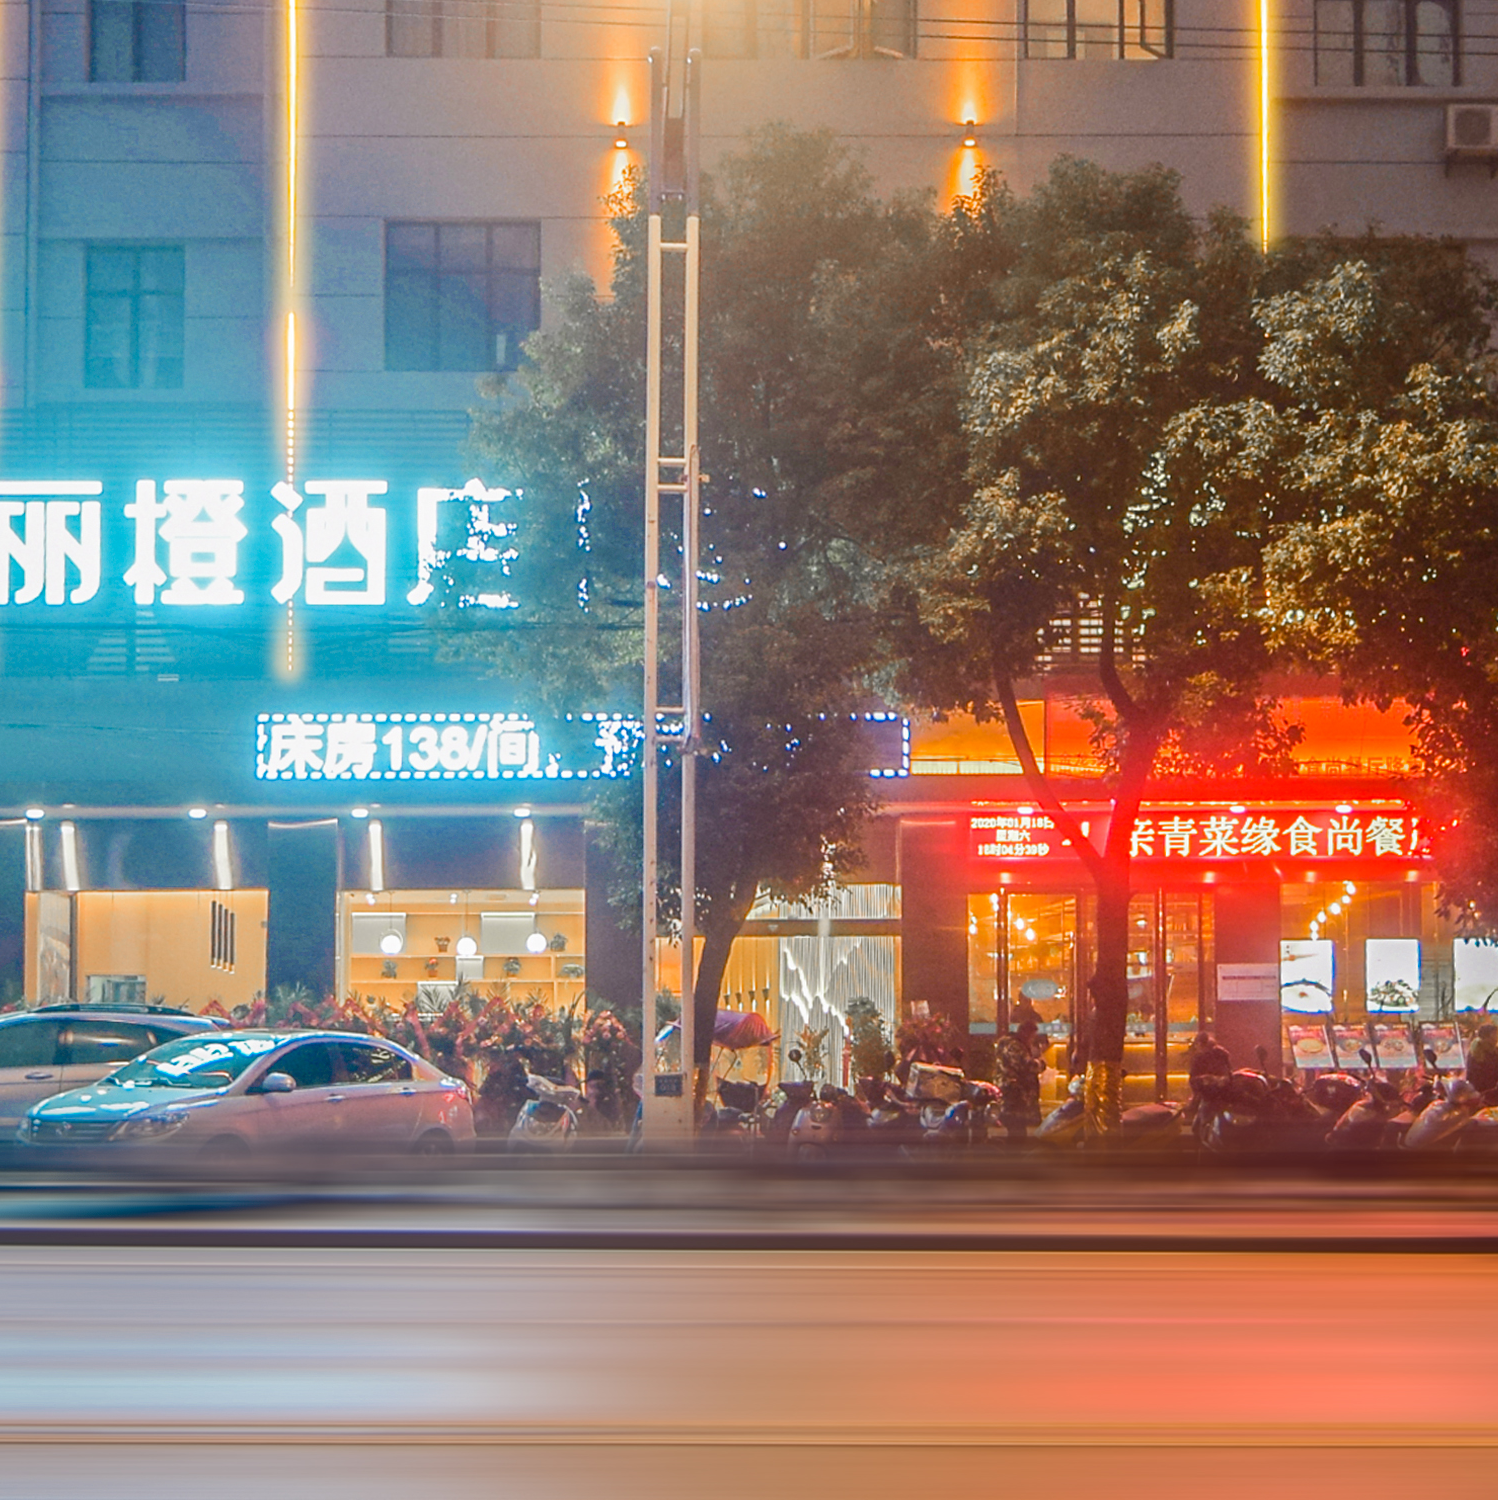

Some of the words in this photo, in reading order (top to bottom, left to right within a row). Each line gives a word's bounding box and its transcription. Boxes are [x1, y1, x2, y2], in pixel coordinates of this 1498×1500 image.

[996, 829, 1031, 842] 星期六
[1129, 815, 1421, 858] 亲青菜缘食尚餐
